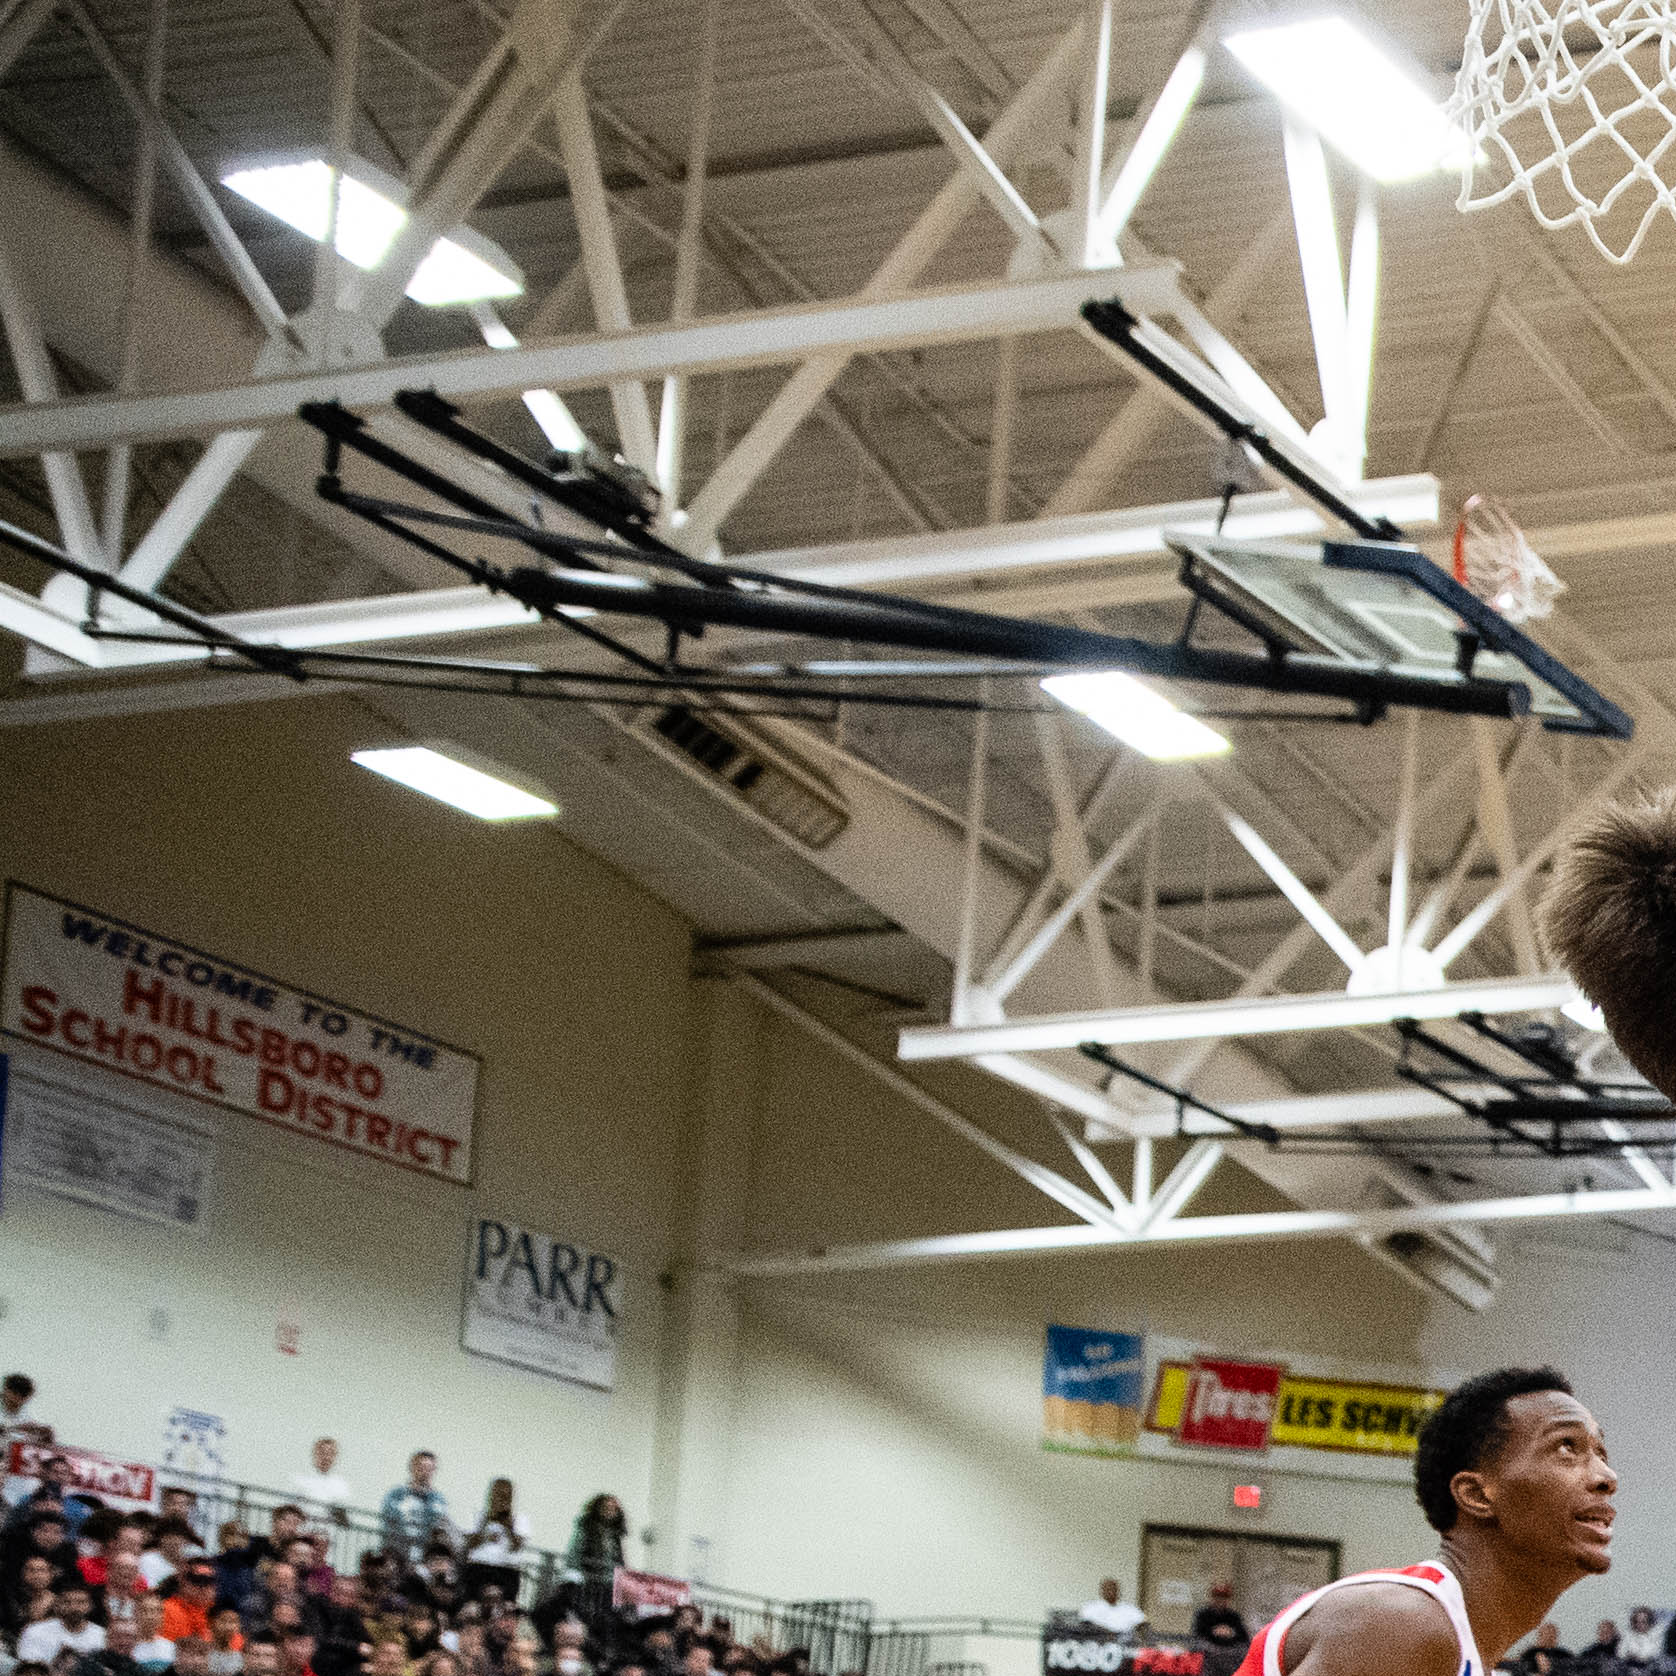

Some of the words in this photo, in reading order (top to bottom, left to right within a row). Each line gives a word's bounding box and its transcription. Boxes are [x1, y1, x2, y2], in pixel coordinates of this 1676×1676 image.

[62, 912, 277, 1011] WELCOME
[301, 1003, 348, 1036] TO
[369, 1026, 437, 1069] THE
[123, 969, 384, 1099] HILLSBORO
[20, 985, 224, 1094] SCHOOL
[257, 1067, 459, 1169] DISTRICT
[476, 1219, 617, 1317] PARR
[1192, 1371, 1272, 1423] Tires
[1280, 1395, 1334, 1429] LES
[1047, 1639, 1124, 1672] 1080
